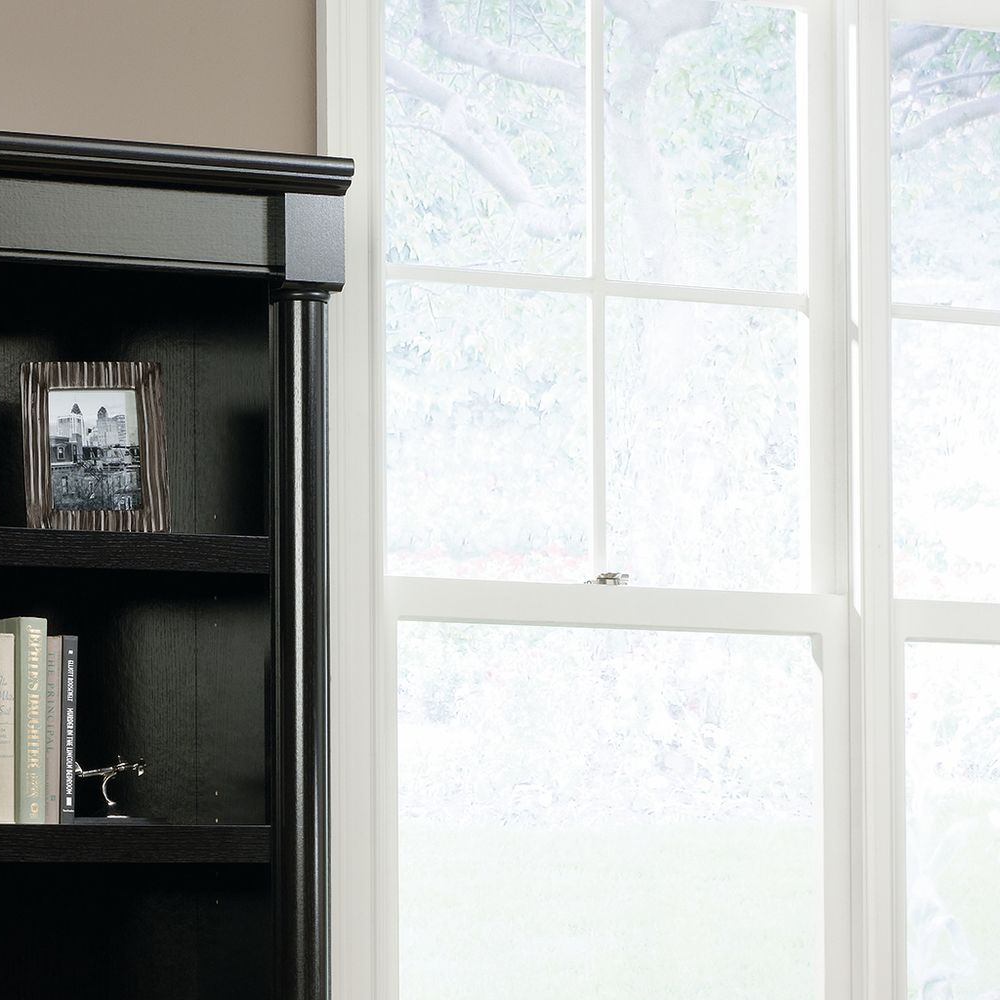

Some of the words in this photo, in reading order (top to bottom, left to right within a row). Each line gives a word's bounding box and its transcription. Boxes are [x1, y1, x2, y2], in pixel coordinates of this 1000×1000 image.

[47, 651, 56, 674] THE
[26, 693, 41, 769] DAUGHTER
[47, 682, 56, 754] PRINCIPAL
[65, 769, 73, 795] BEDROOM
